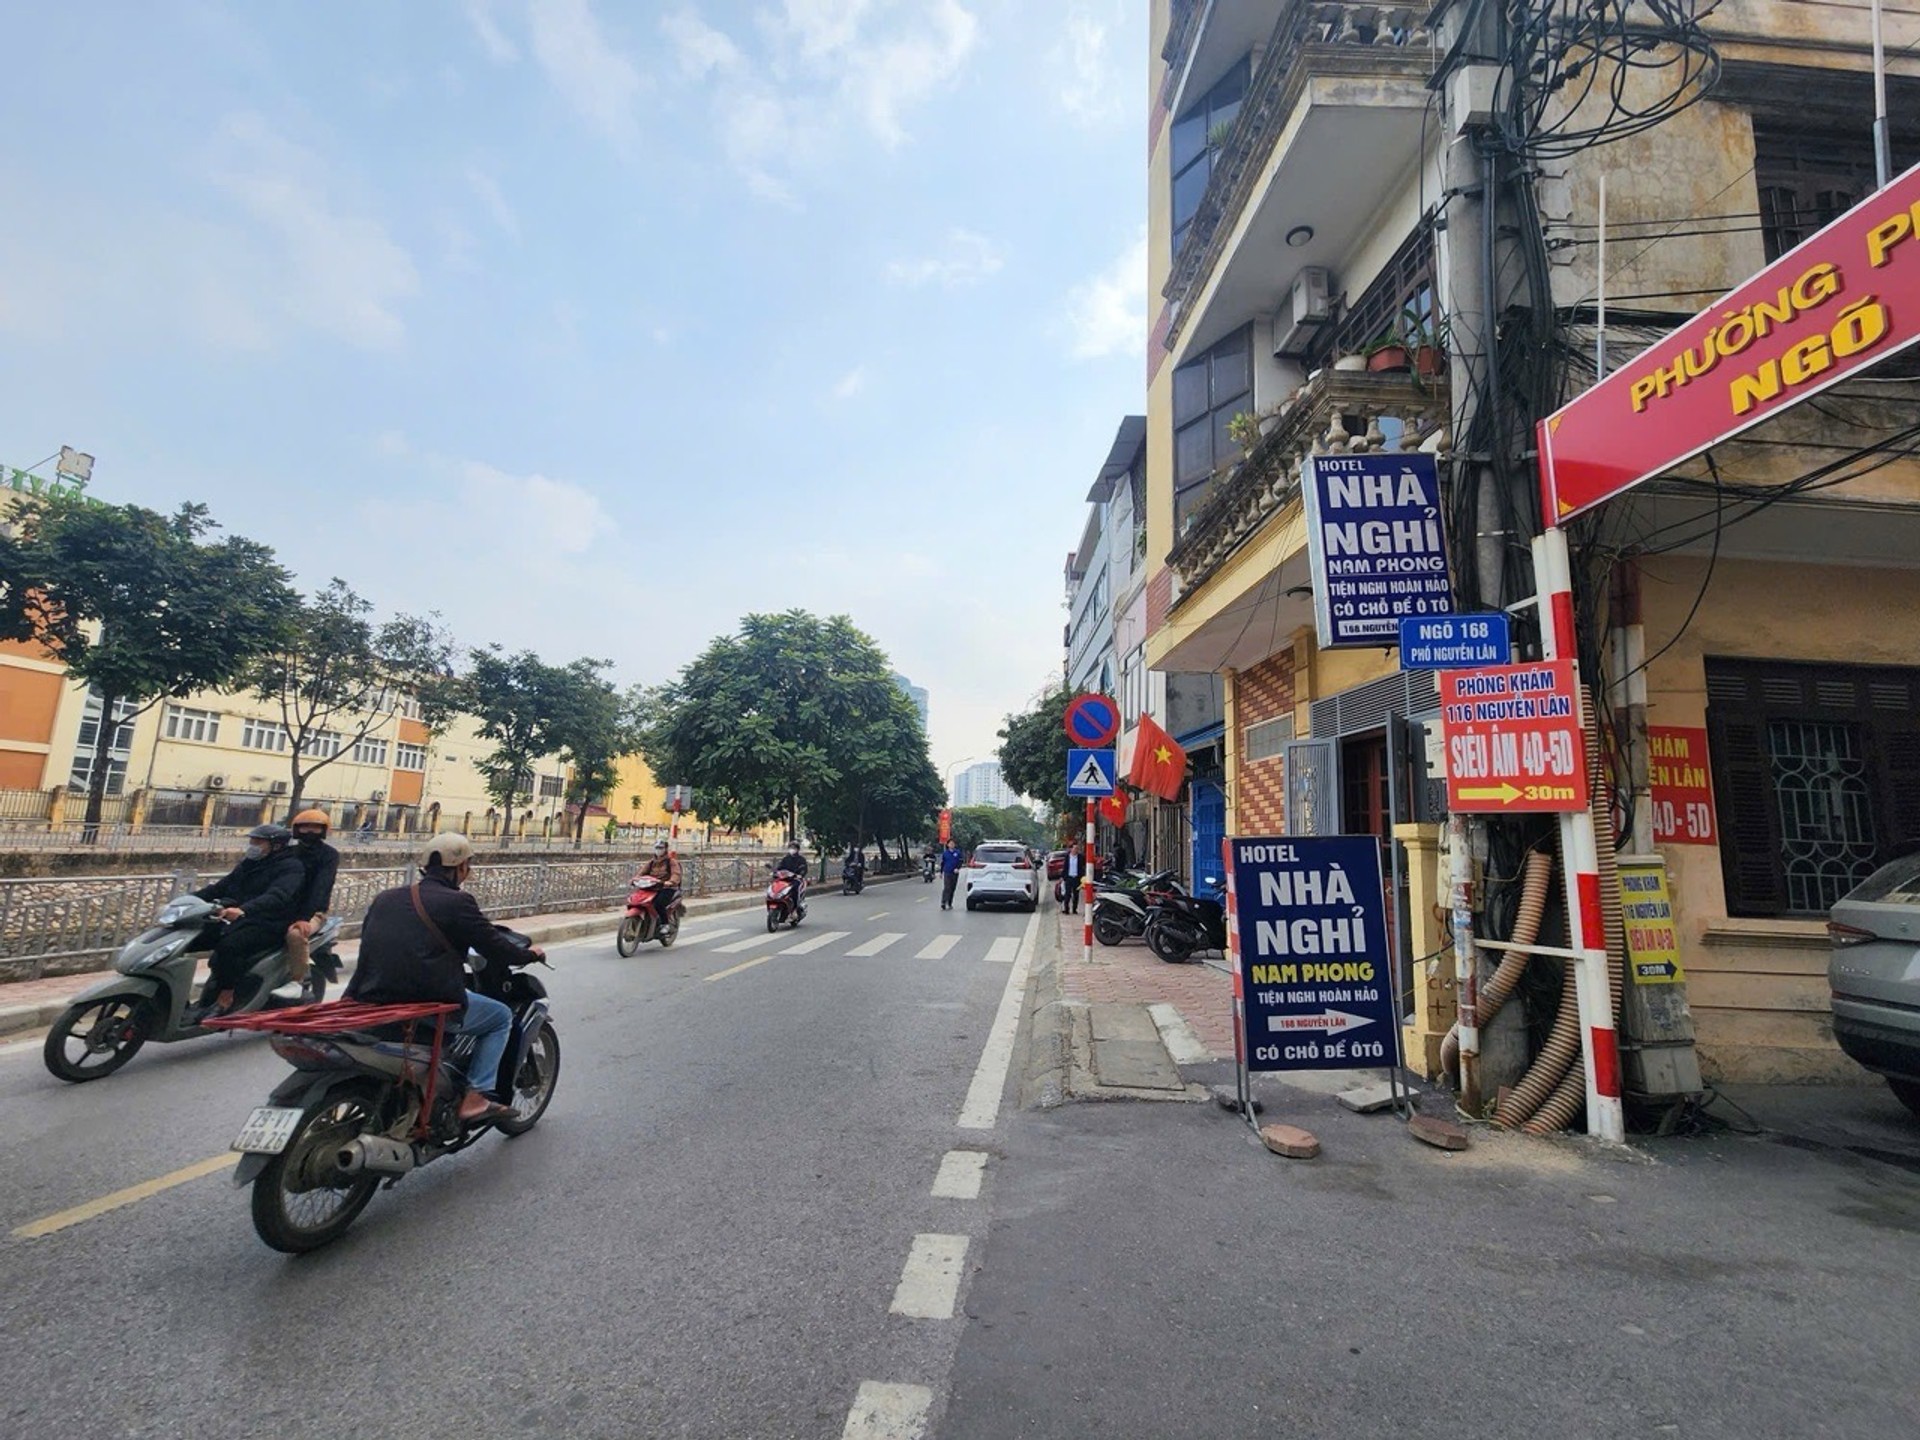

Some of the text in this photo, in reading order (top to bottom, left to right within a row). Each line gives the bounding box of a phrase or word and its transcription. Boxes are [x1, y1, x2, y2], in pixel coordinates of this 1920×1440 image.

[1630, 262, 1841, 413] PHƯỜNG
[1730, 295, 1887, 415] NGÕ
[1318, 460, 1366, 472] HOTEL
[1327, 467, 1428, 508] NHÀ
[1324, 507, 1440, 556] NGHỈ
[1328, 556, 1445, 575] NAM PHONG
[1329, 581, 1356, 598] TIỆN
[1359, 581, 1387, 595] NGHI
[1390, 578, 1423, 593] HOÀN
[1333, 596, 1449, 616] CÓ CHỖ ĐỂ Ô TÔ
[1420, 621, 1489, 639] NGÕ 168
[1411, 642, 1497, 661] PHỐ NGUYỄN LÂN
[1456, 667, 1555, 697] PHÒNG KHÁM
[1447, 693, 1571, 723] 116 NGUYỄN LÂN
[1451, 726, 1488, 778] SIÊU
[1491, 724, 1519, 777] ÂM
[1522, 730, 1574, 776] 4D-5D
[1673, 763, 1706, 788] LÂN
[1524, 786, 1575, 800] 30m
[1240, 845, 1300, 863] HOTEL
[1259, 862, 1356, 906] NHÀ
[1256, 905, 1366, 955] NGHỈ
[1252, 961, 1374, 984] NAM PHONG
[1641, 964, 1666, 975] 30M
[1257, 985, 1379, 1006] TIỆN NGHI HOÀN HẢO
[1256, 1039, 1384, 1060] CÓ CHỖ ĐỂ ÔTÔ
